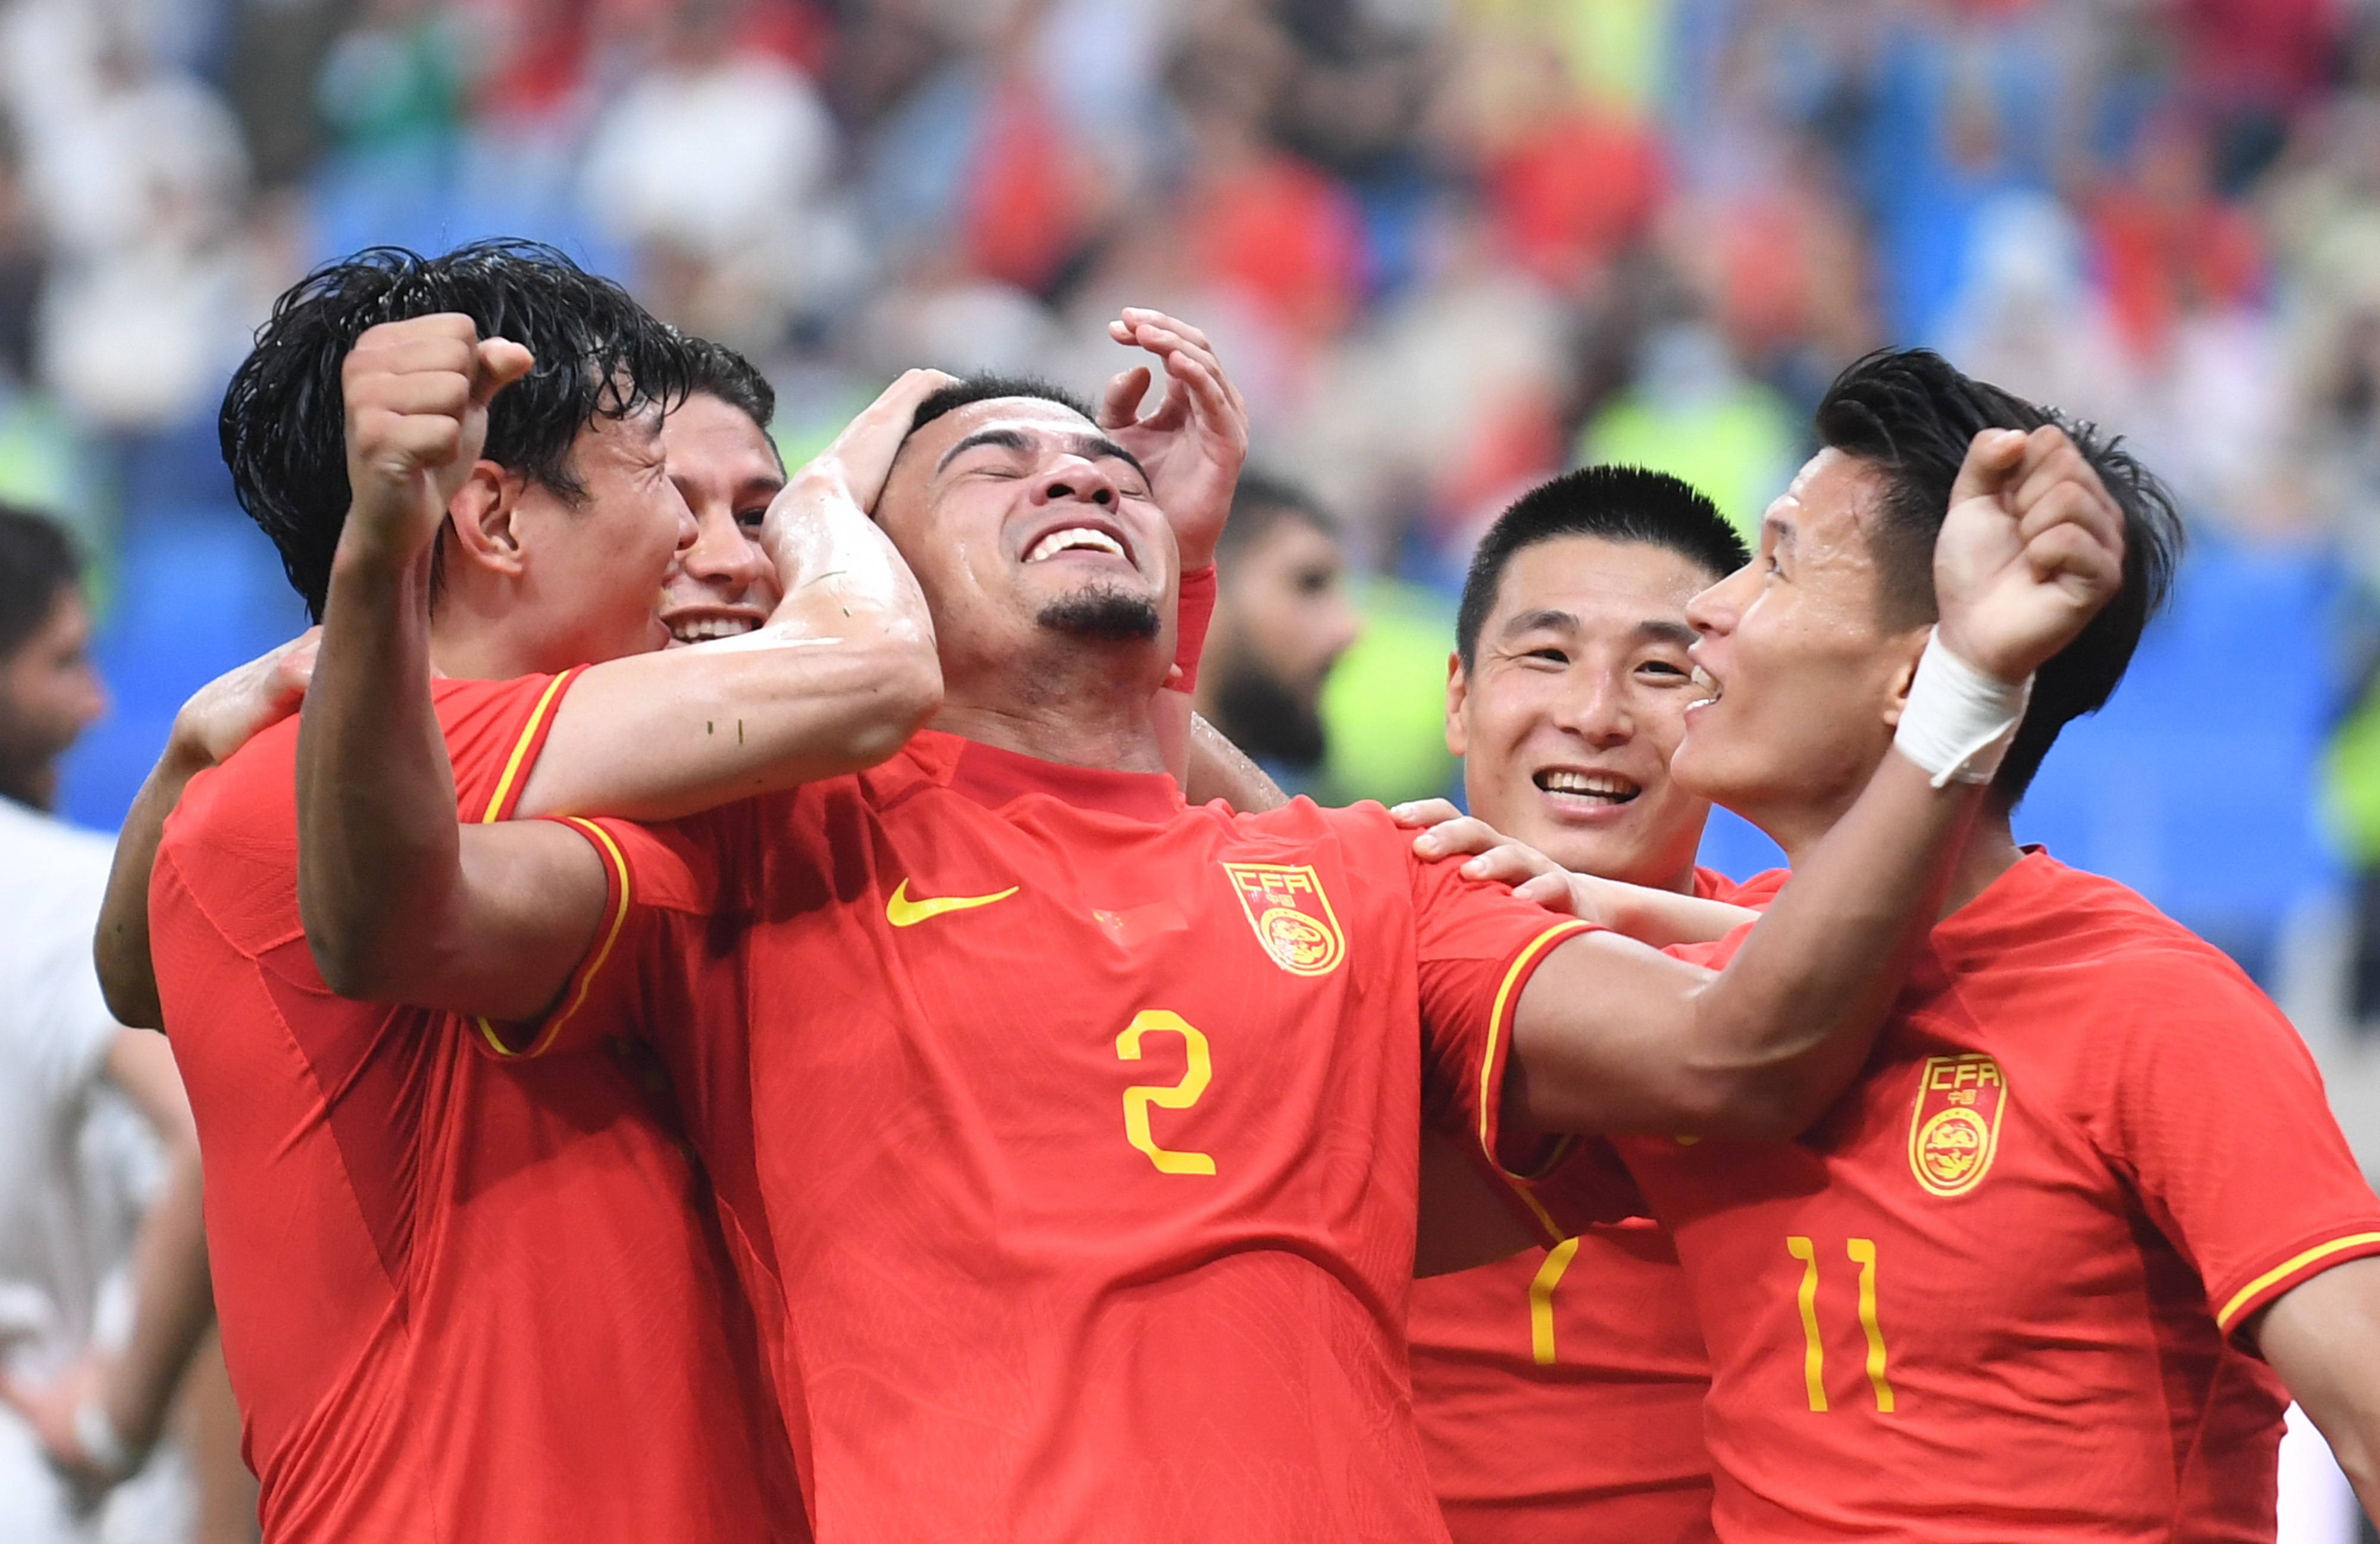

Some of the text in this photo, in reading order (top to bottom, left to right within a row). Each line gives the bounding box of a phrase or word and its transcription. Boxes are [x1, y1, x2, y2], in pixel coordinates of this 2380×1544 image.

[1234, 870, 1313, 894] CFA
[1115, 1009, 1217, 1176] 2
[1930, 1062, 2000, 1089] CFA
[1786, 1235, 1895, 1413] 11
